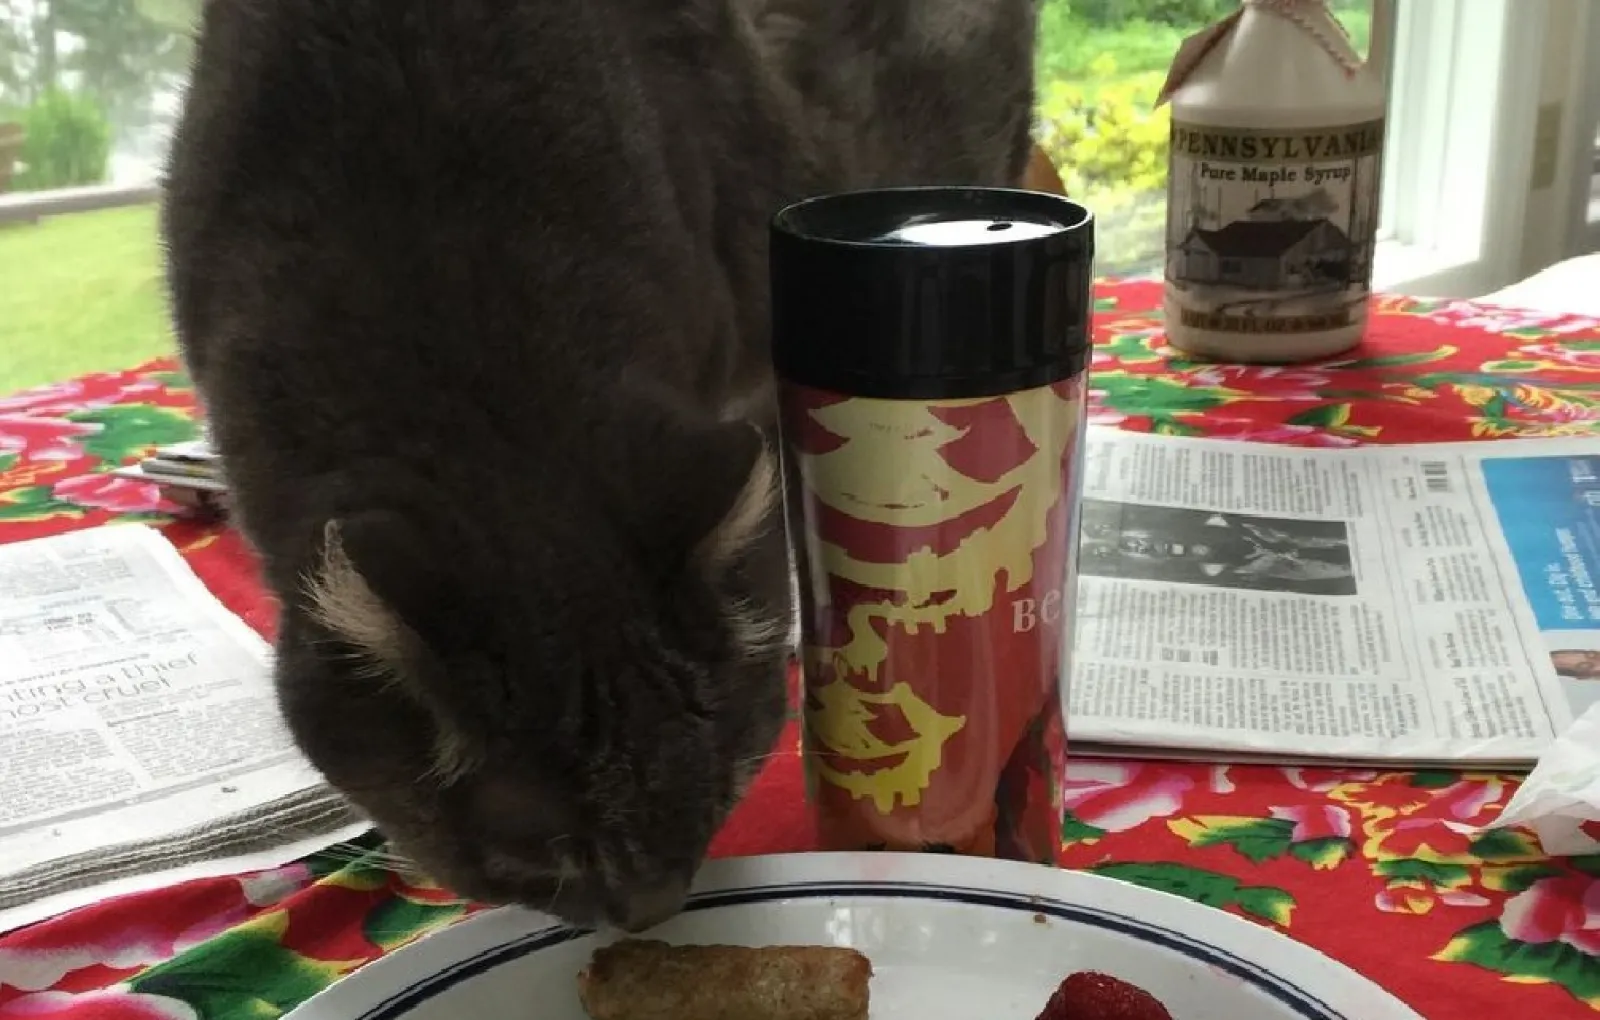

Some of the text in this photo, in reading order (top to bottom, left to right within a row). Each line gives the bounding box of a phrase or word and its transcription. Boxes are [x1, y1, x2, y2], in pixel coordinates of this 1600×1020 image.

[1201, 162, 1350, 187] Pure Maple Syrup
[95, 674, 116, 686] a
[121, 651, 198, 681] thief
[83, 676, 171, 704] cruel
